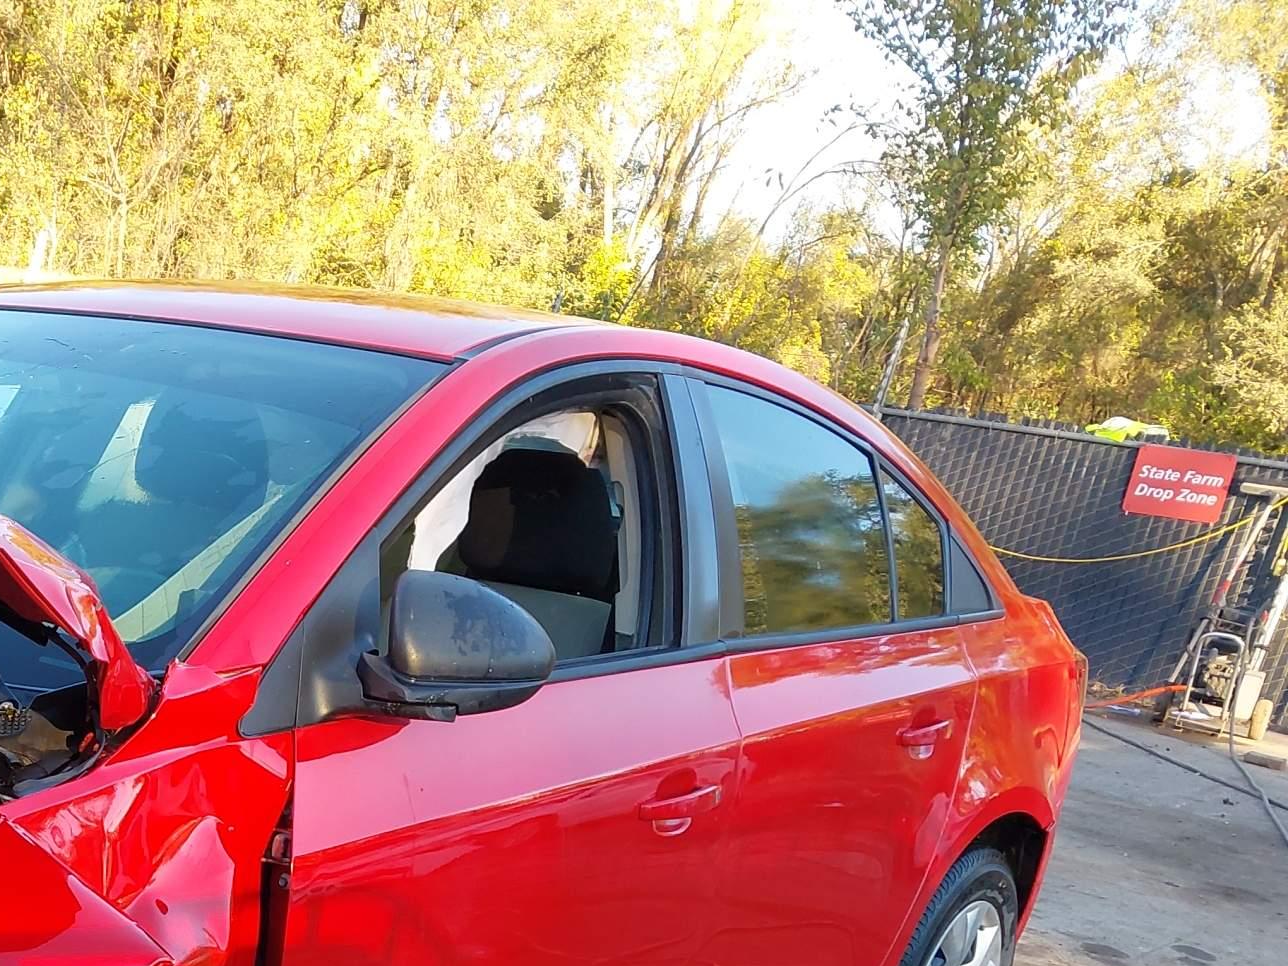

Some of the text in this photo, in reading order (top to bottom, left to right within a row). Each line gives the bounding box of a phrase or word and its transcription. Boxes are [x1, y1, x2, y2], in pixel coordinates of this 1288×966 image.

[1138, 464, 1225, 487] State Farm
[1134, 483, 1218, 506] Drop Zone
